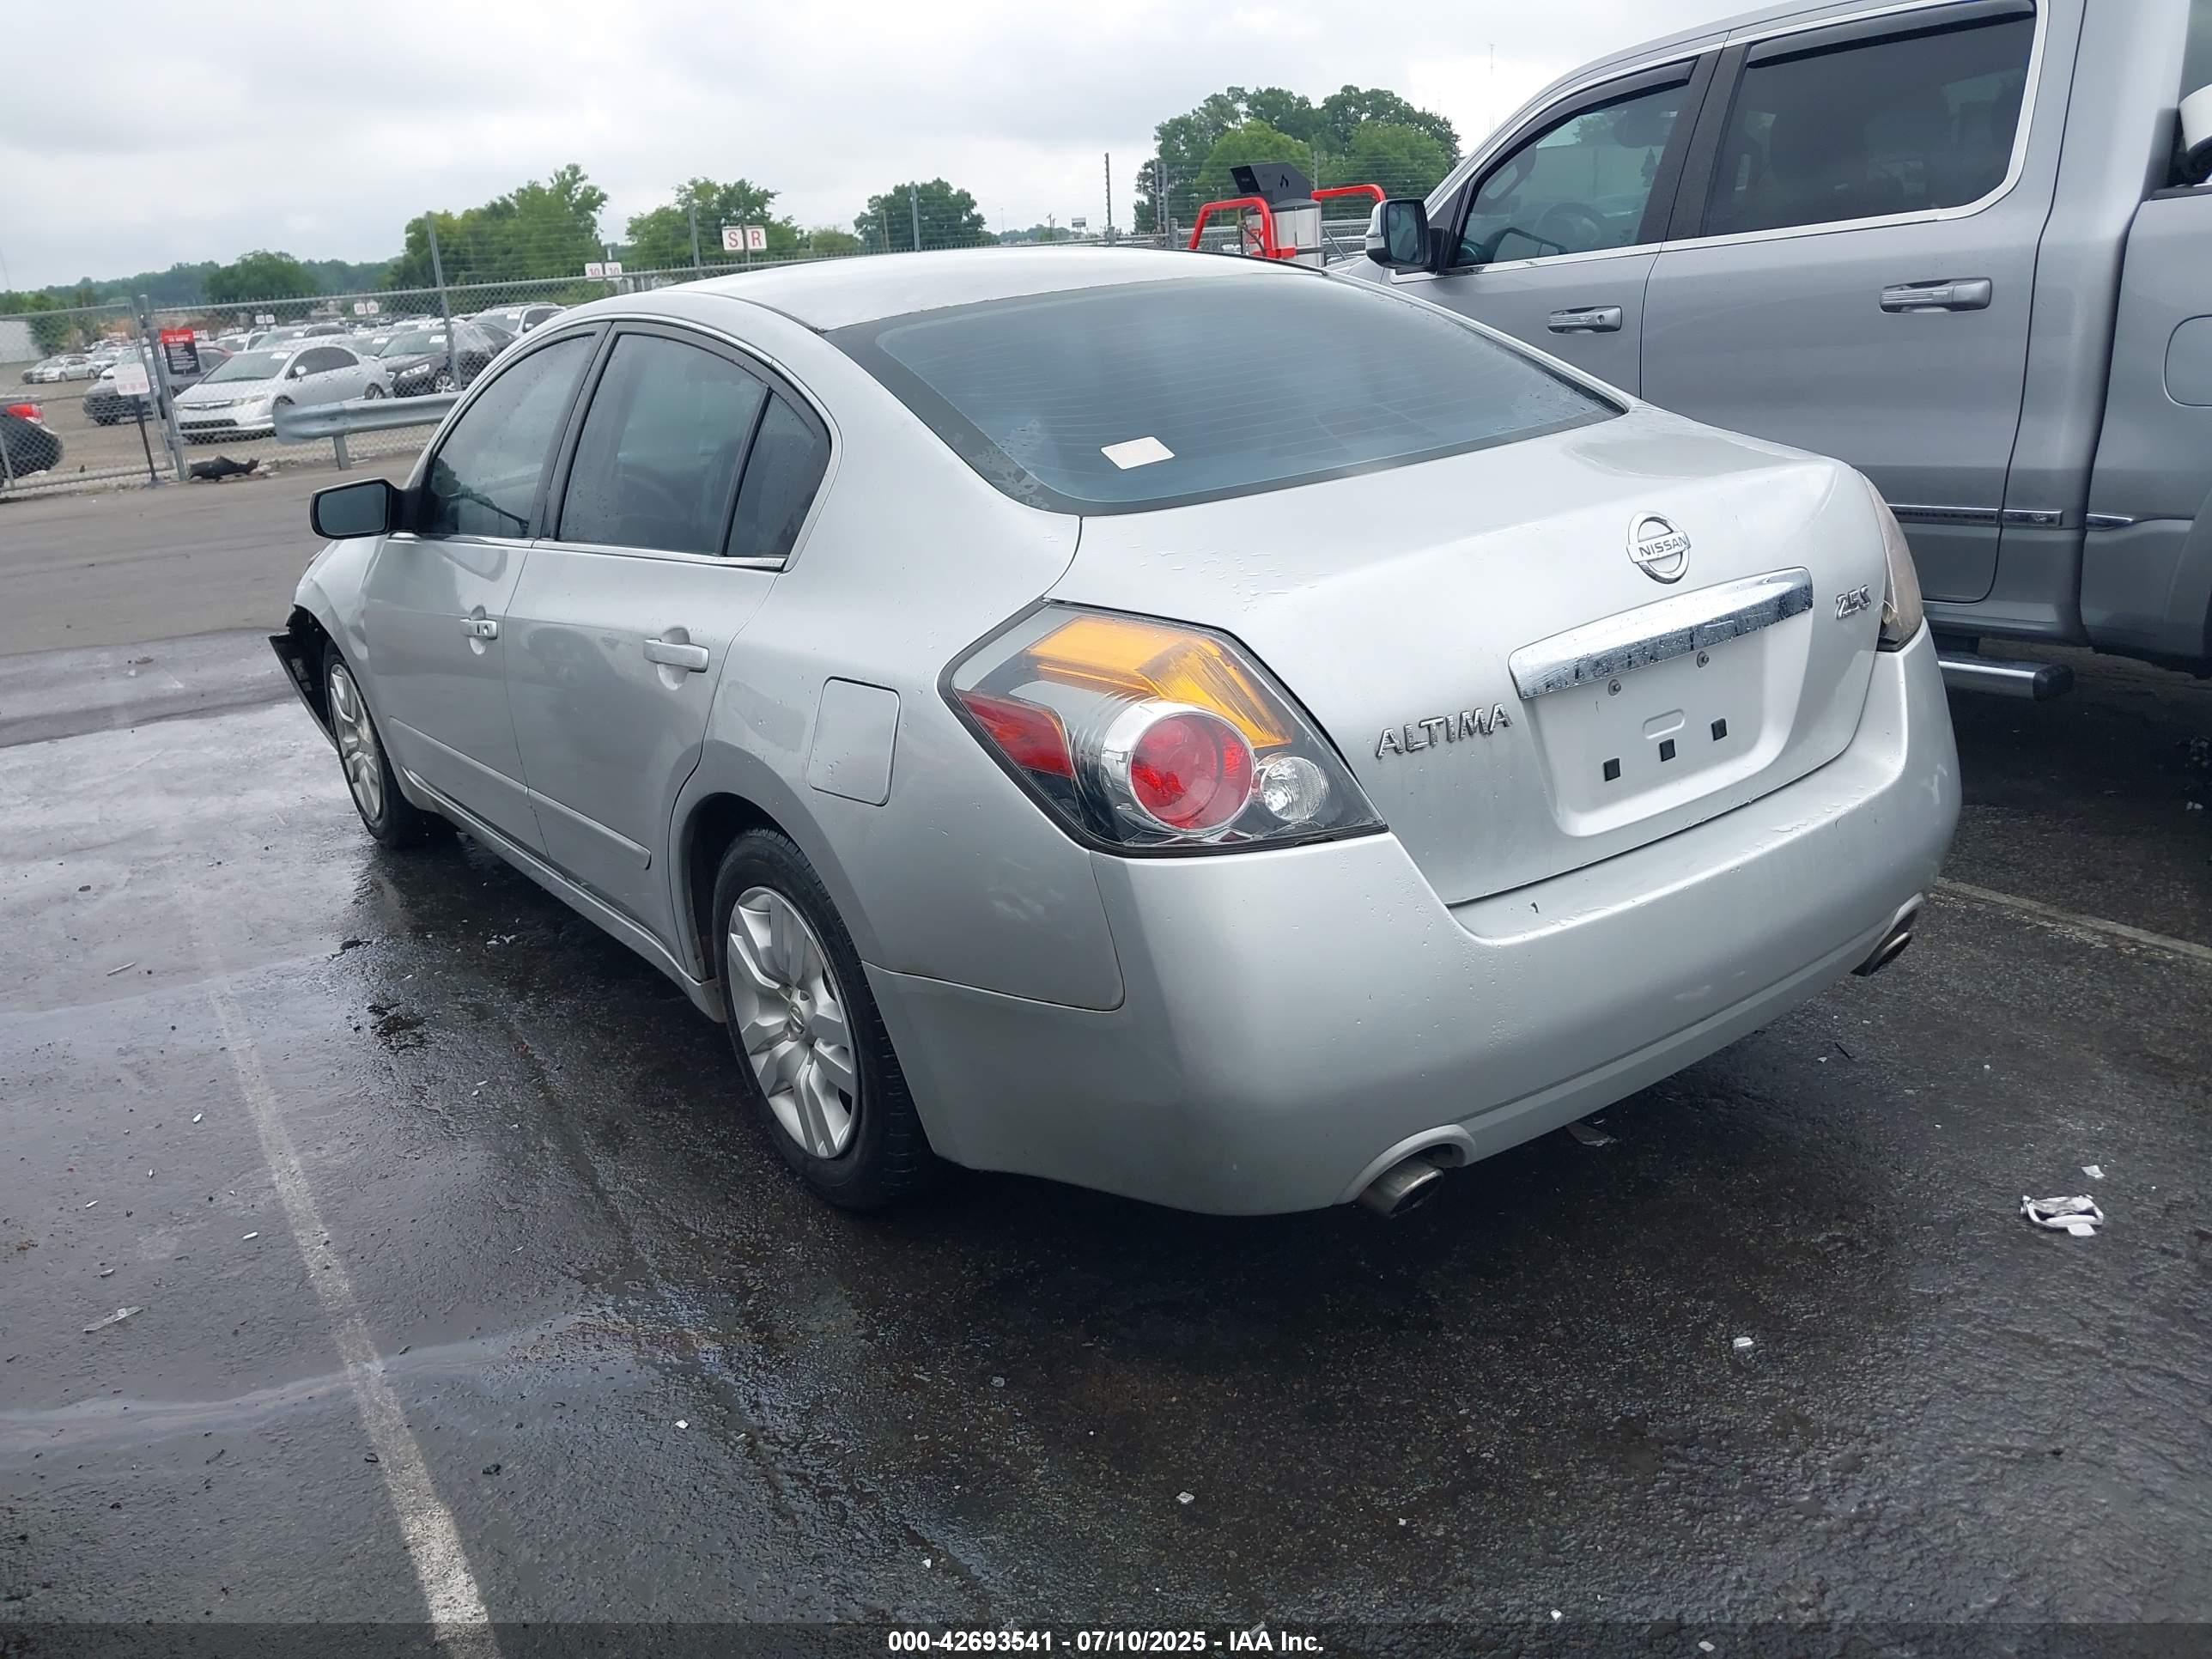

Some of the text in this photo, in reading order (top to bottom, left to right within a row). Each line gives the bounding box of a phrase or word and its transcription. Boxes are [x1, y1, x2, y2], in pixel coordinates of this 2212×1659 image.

[728, 230, 762, 247] S R
[1638, 535, 1687, 556] NISSAN
[1376, 702, 1513, 760] ALTIMA
